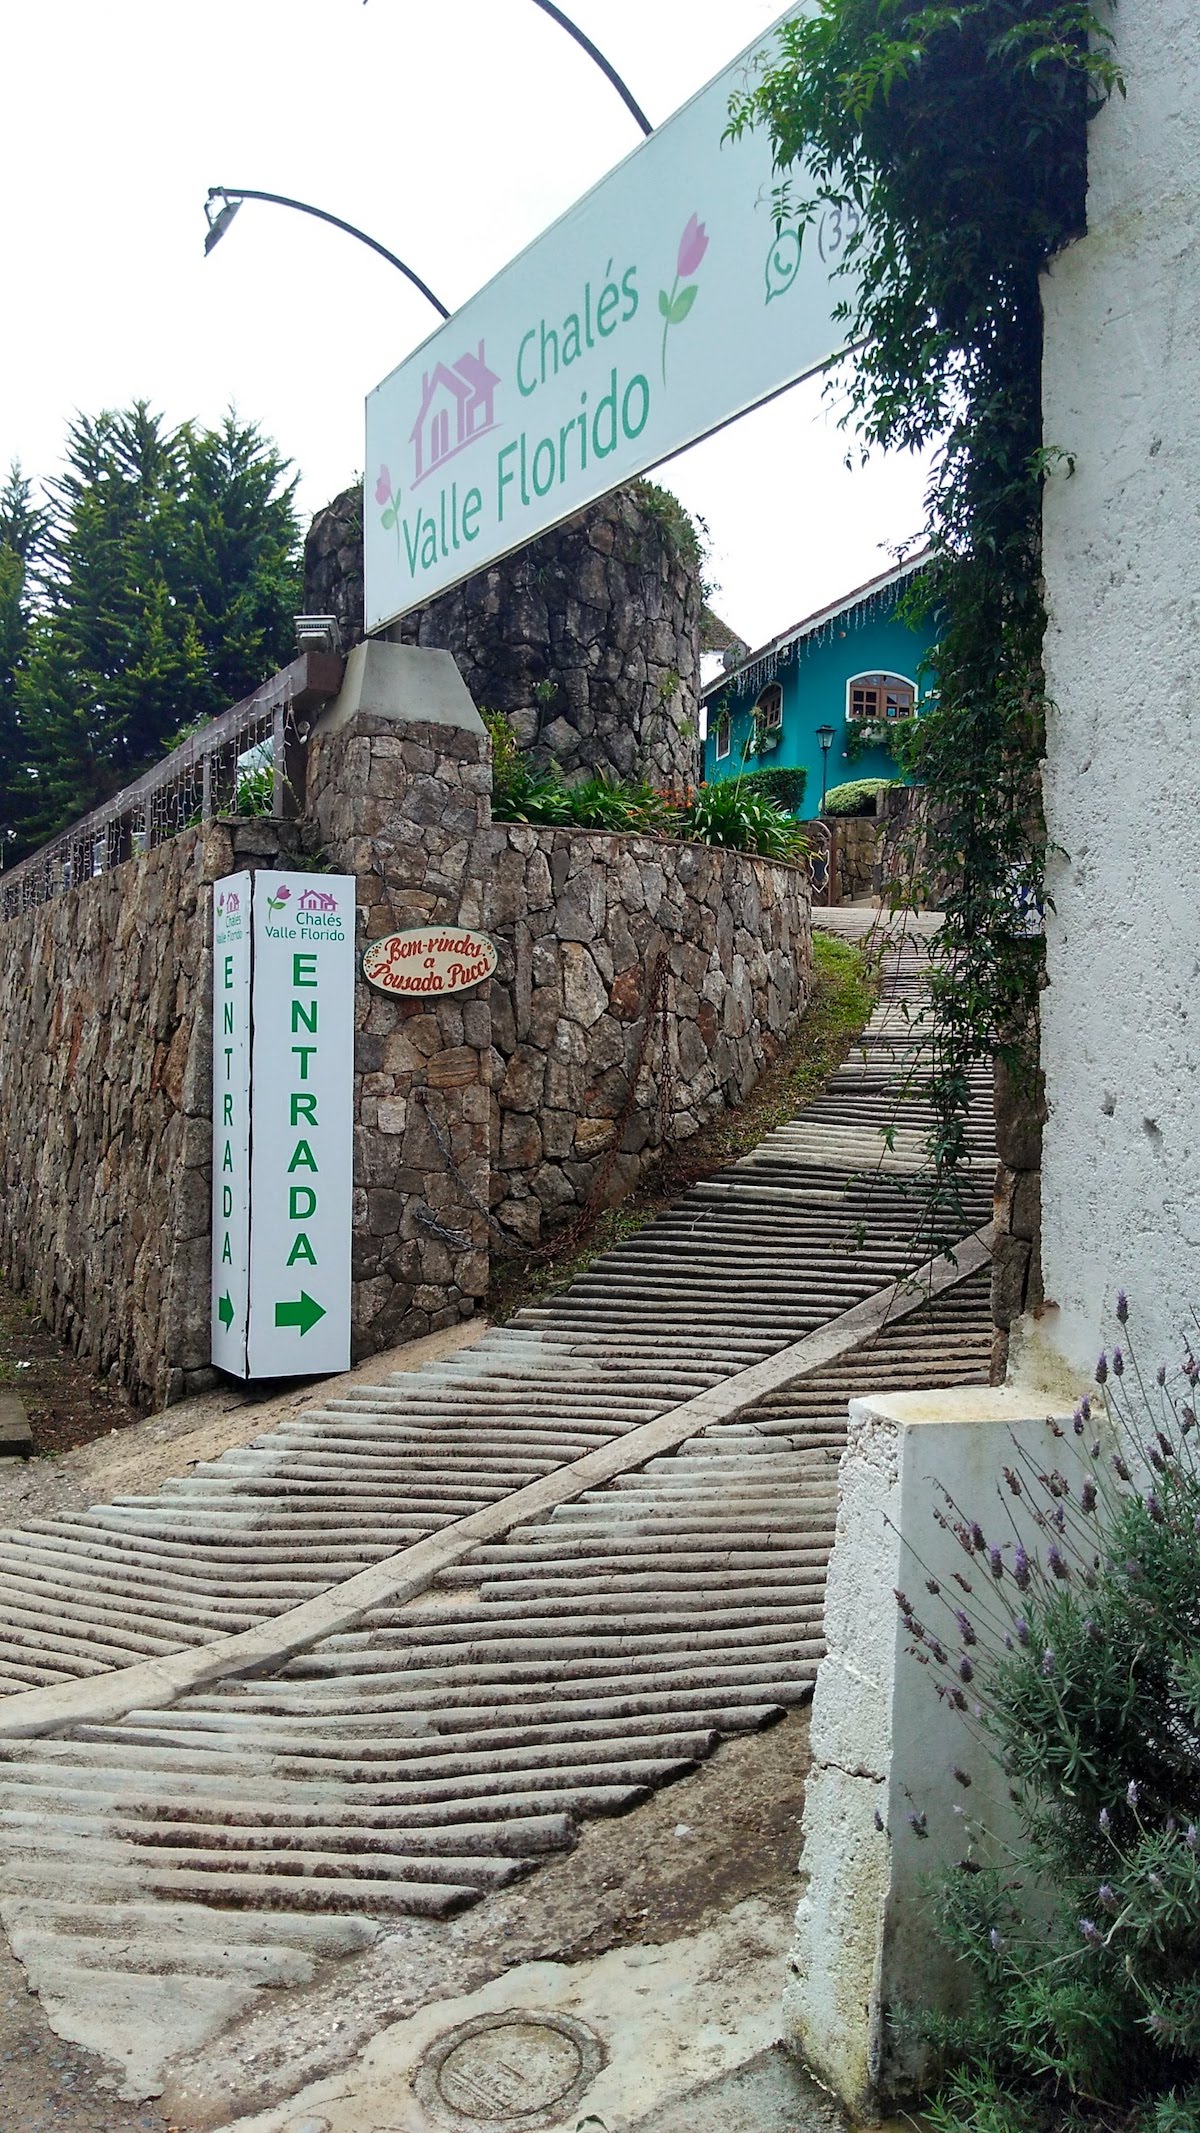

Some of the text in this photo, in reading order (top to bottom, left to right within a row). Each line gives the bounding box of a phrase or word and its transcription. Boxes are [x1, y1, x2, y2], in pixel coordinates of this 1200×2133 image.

[516, 257, 639, 398] Chalés
[402, 367, 650, 578] Valle Florido
[265, 926, 345, 942] Valle Florido
[296, 912, 342, 927] Chalés
[423, 957, 436, 969] a
[368, 953, 491, 992] Pousada Pucci
[223, 955, 233, 1265] ENTRADA
[287, 953, 319, 1266] ENTRADA
